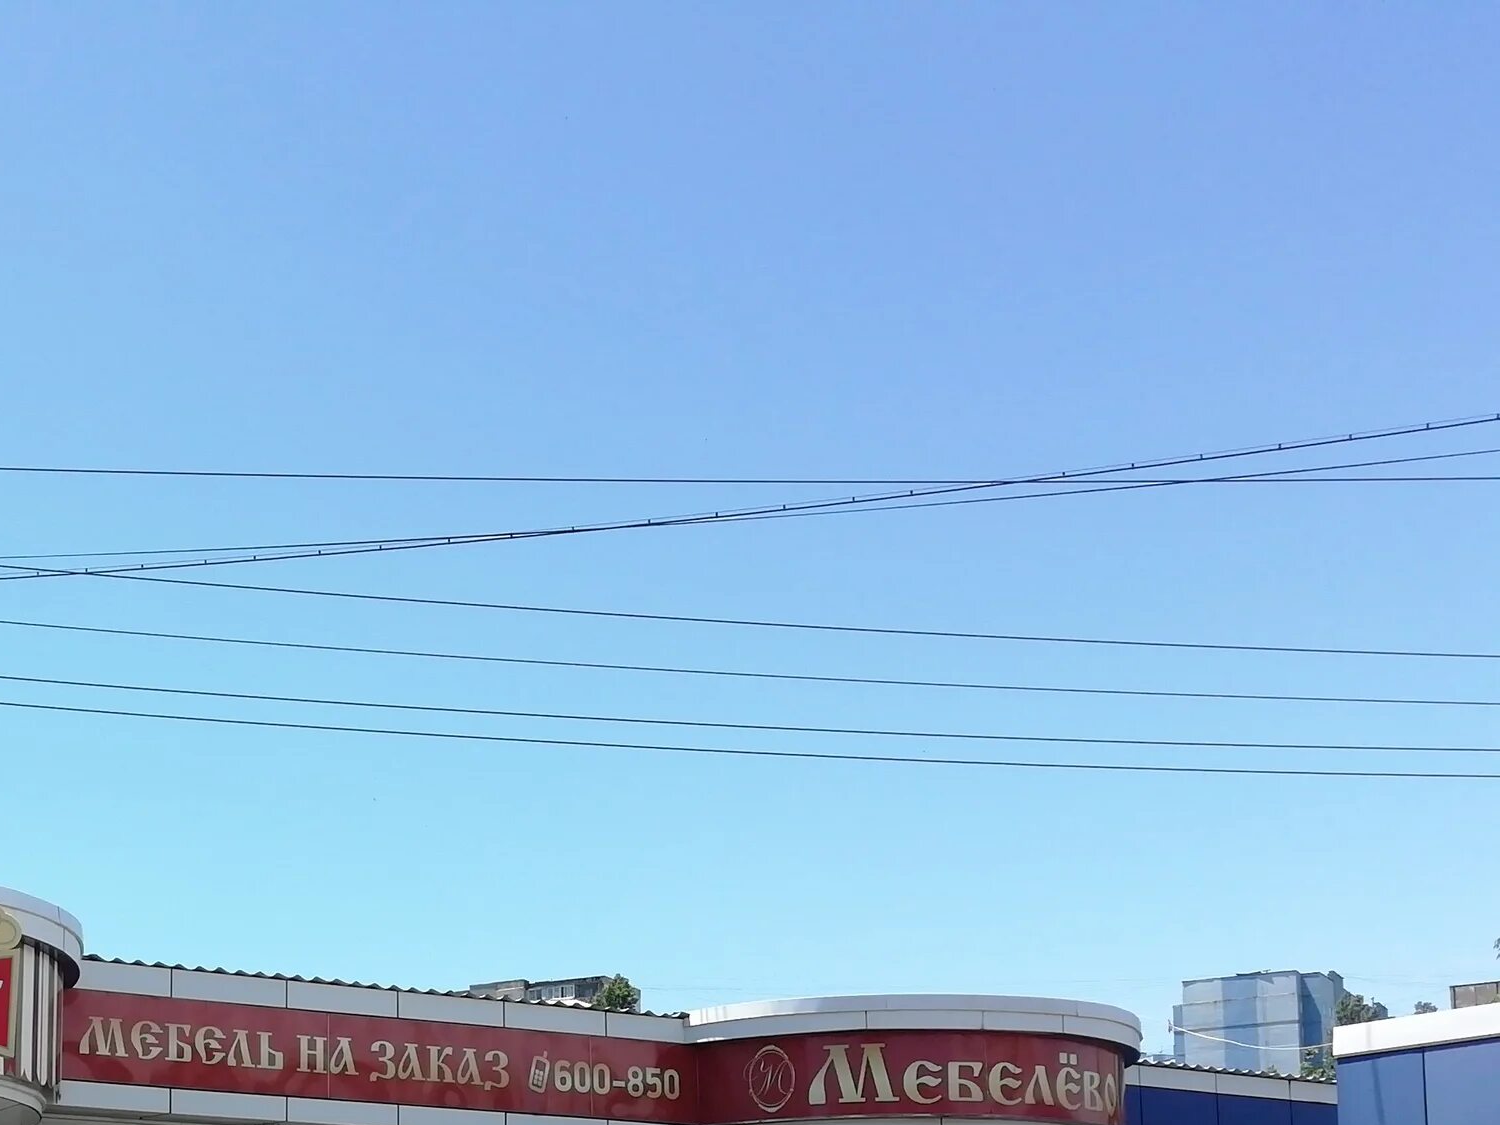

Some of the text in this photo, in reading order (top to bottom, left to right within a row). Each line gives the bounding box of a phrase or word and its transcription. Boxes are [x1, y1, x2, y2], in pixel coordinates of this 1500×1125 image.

[79, 1016, 681, 1101] МЕБЕЛЬ НА ЗАКАЗ 600-850
